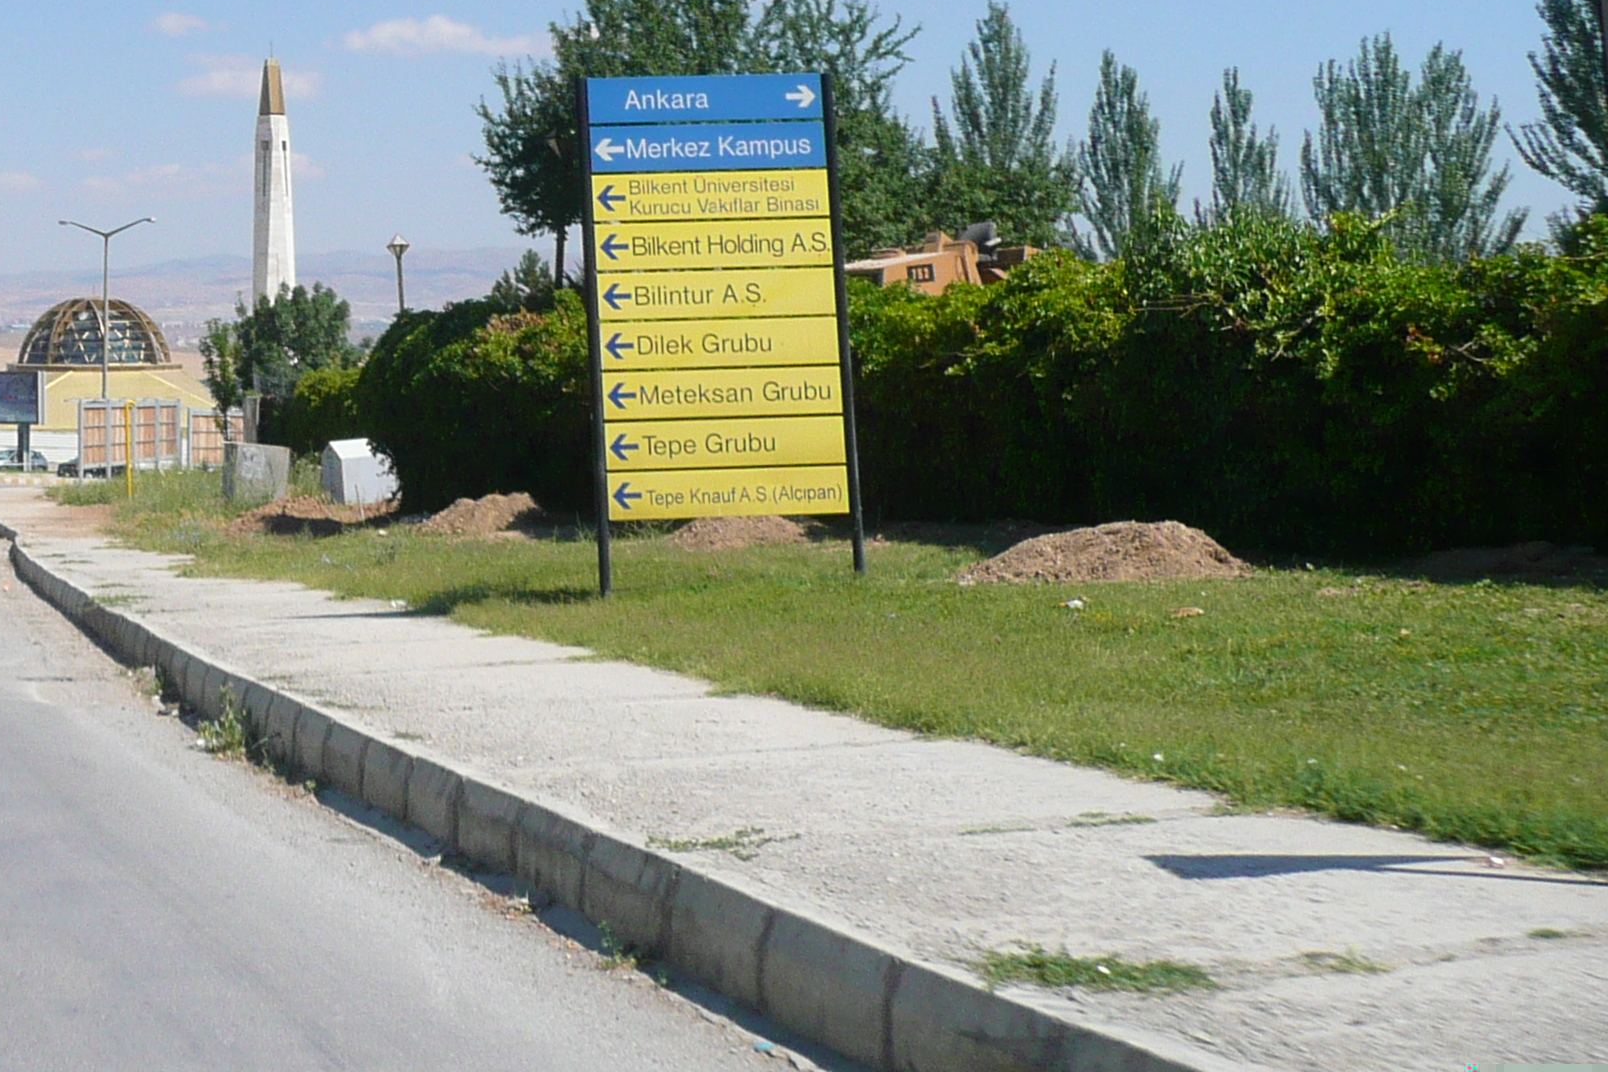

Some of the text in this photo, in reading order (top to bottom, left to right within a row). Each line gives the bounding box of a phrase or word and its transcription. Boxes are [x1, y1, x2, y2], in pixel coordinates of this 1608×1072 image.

[625, 89, 709, 110] Ankara
[627, 136, 811, 159] Merkez Kampus
[628, 176, 795, 195] Bilkent Üniversitesi
[629, 199, 691, 215] Kurucu
[697, 198, 759, 213] Vakıflar
[632, 236, 700, 256] Bilkent
[707, 234, 784, 256] Holding
[635, 285, 713, 305] Bilintur
[637, 334, 772, 355] Dilek Grubu
[640, 381, 831, 405] Meteksan Grubu
[642, 433, 776, 458] Tepe Grubu
[646, 489, 684, 508] Tepe
[690, 488, 736, 504] Knauf
